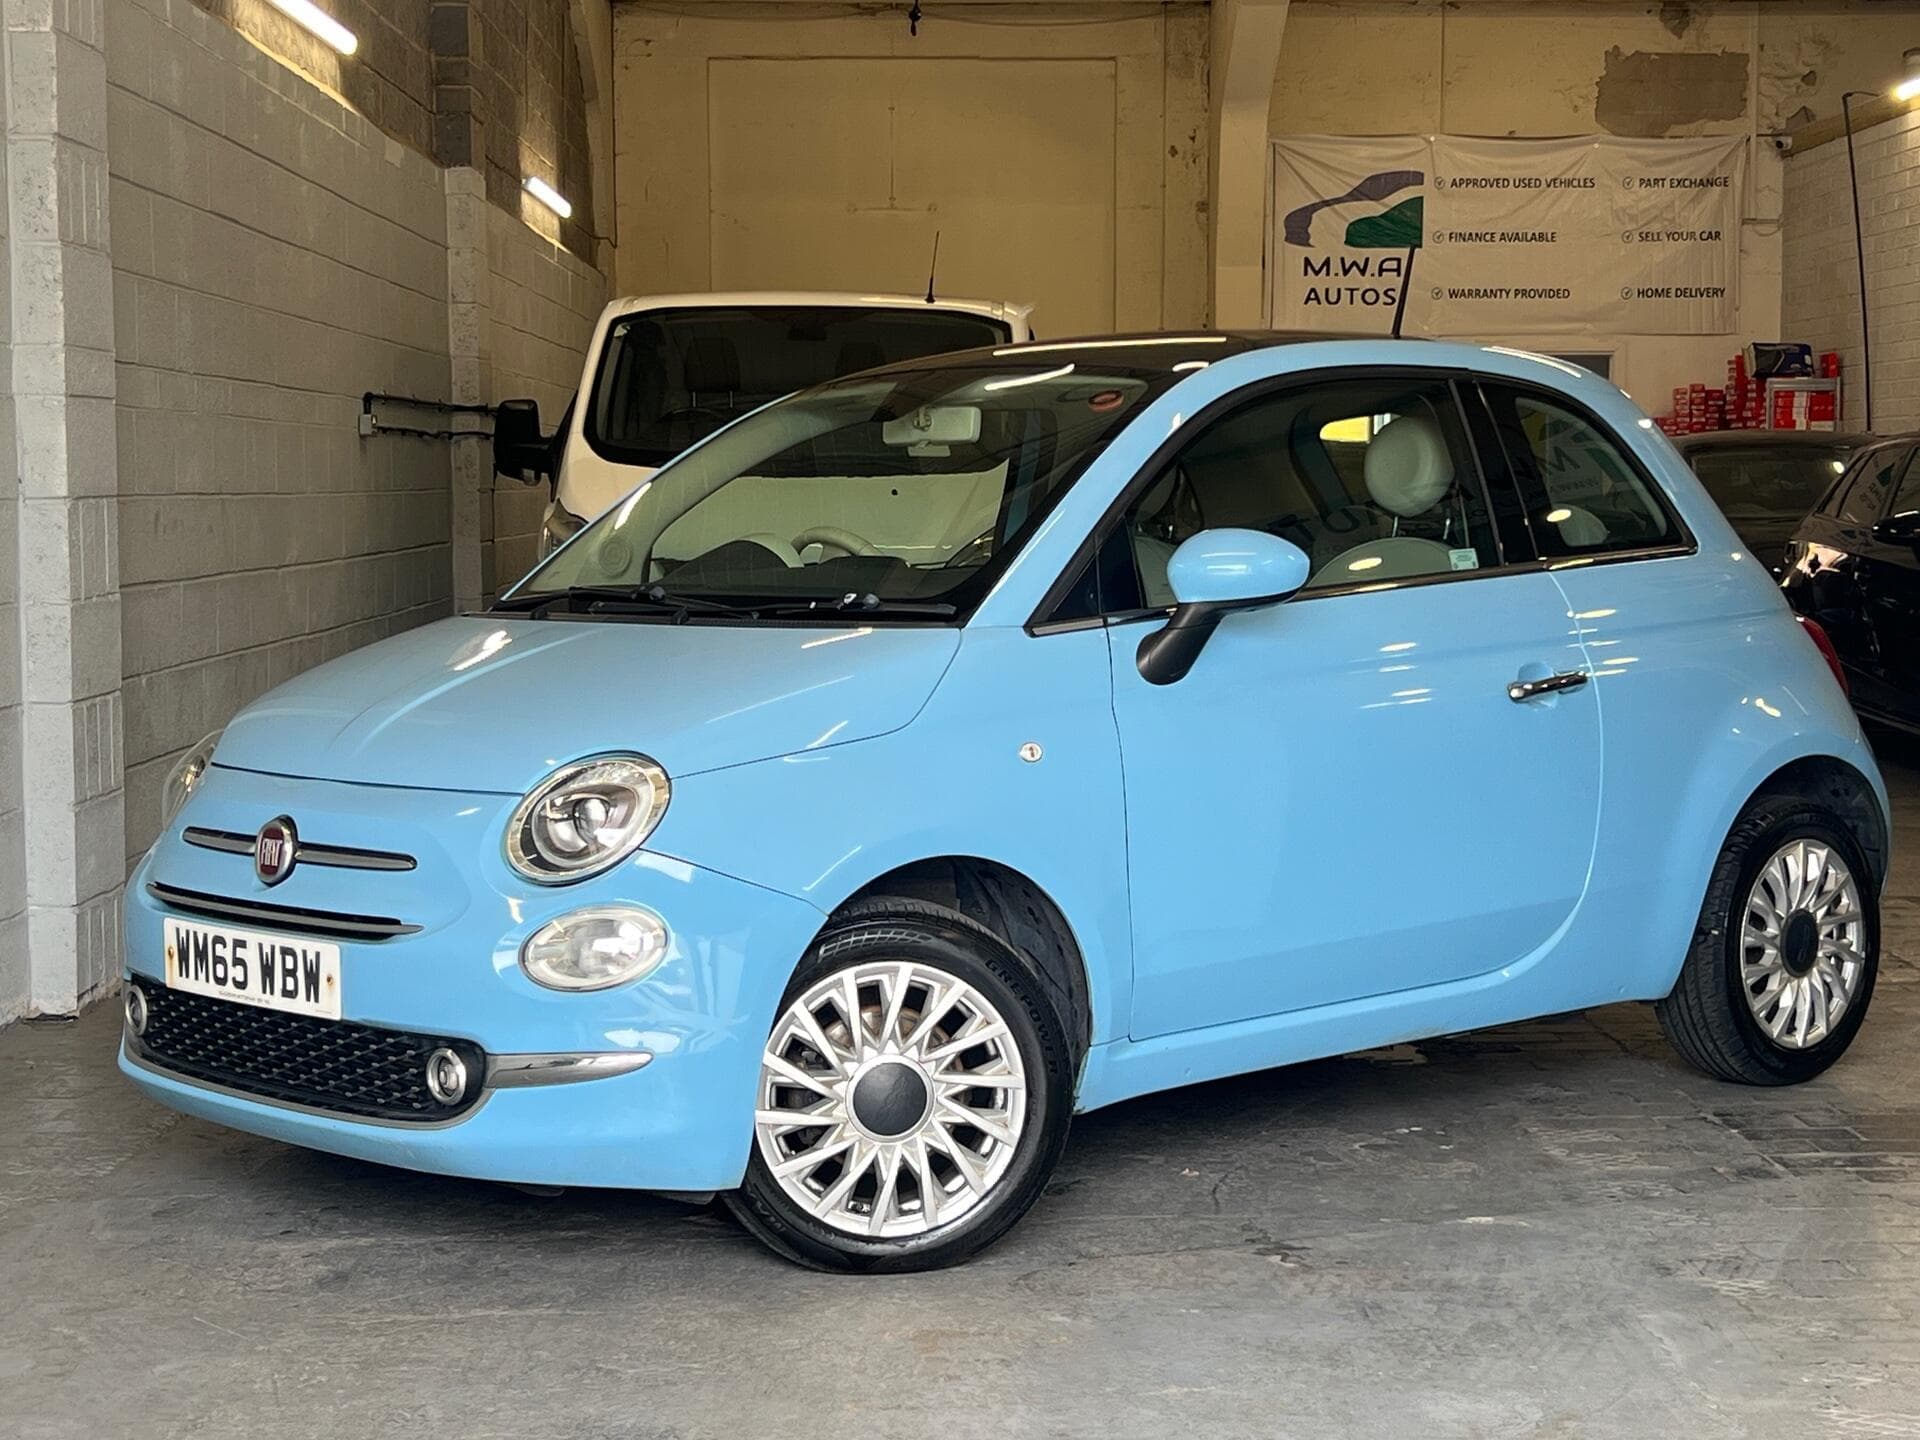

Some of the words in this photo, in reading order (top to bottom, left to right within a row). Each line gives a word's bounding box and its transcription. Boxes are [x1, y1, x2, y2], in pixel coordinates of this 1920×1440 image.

[1450, 177, 1510, 189] APPROVED
[1513, 177, 1542, 189] USED
[1545, 177, 1596, 189] VEHICLES
[1639, 178, 1666, 189] PART
[1669, 176, 1729, 189] EXCHANGE
[1448, 232, 1496, 243] FINANCE
[1499, 232, 1557, 243] AVAILABLE
[1638, 231, 1662, 242] SELL
[1665, 231, 1697, 242] YOUR
[1699, 230, 1721, 242] CAR
[1303, 256, 1401, 277] M.W.A
[1303, 287, 1396, 306] AUTOS
[1448, 288, 1512, 299] WARRANTY
[1514, 288, 1571, 299] PROVIDED
[1637, 287, 1672, 298] HOME
[1675, 287, 1726, 298] DELIVERY
[261, 838, 283, 866] FIAT
[175, 926, 249, 990] WM65
[257, 942, 321, 1004] WBW
